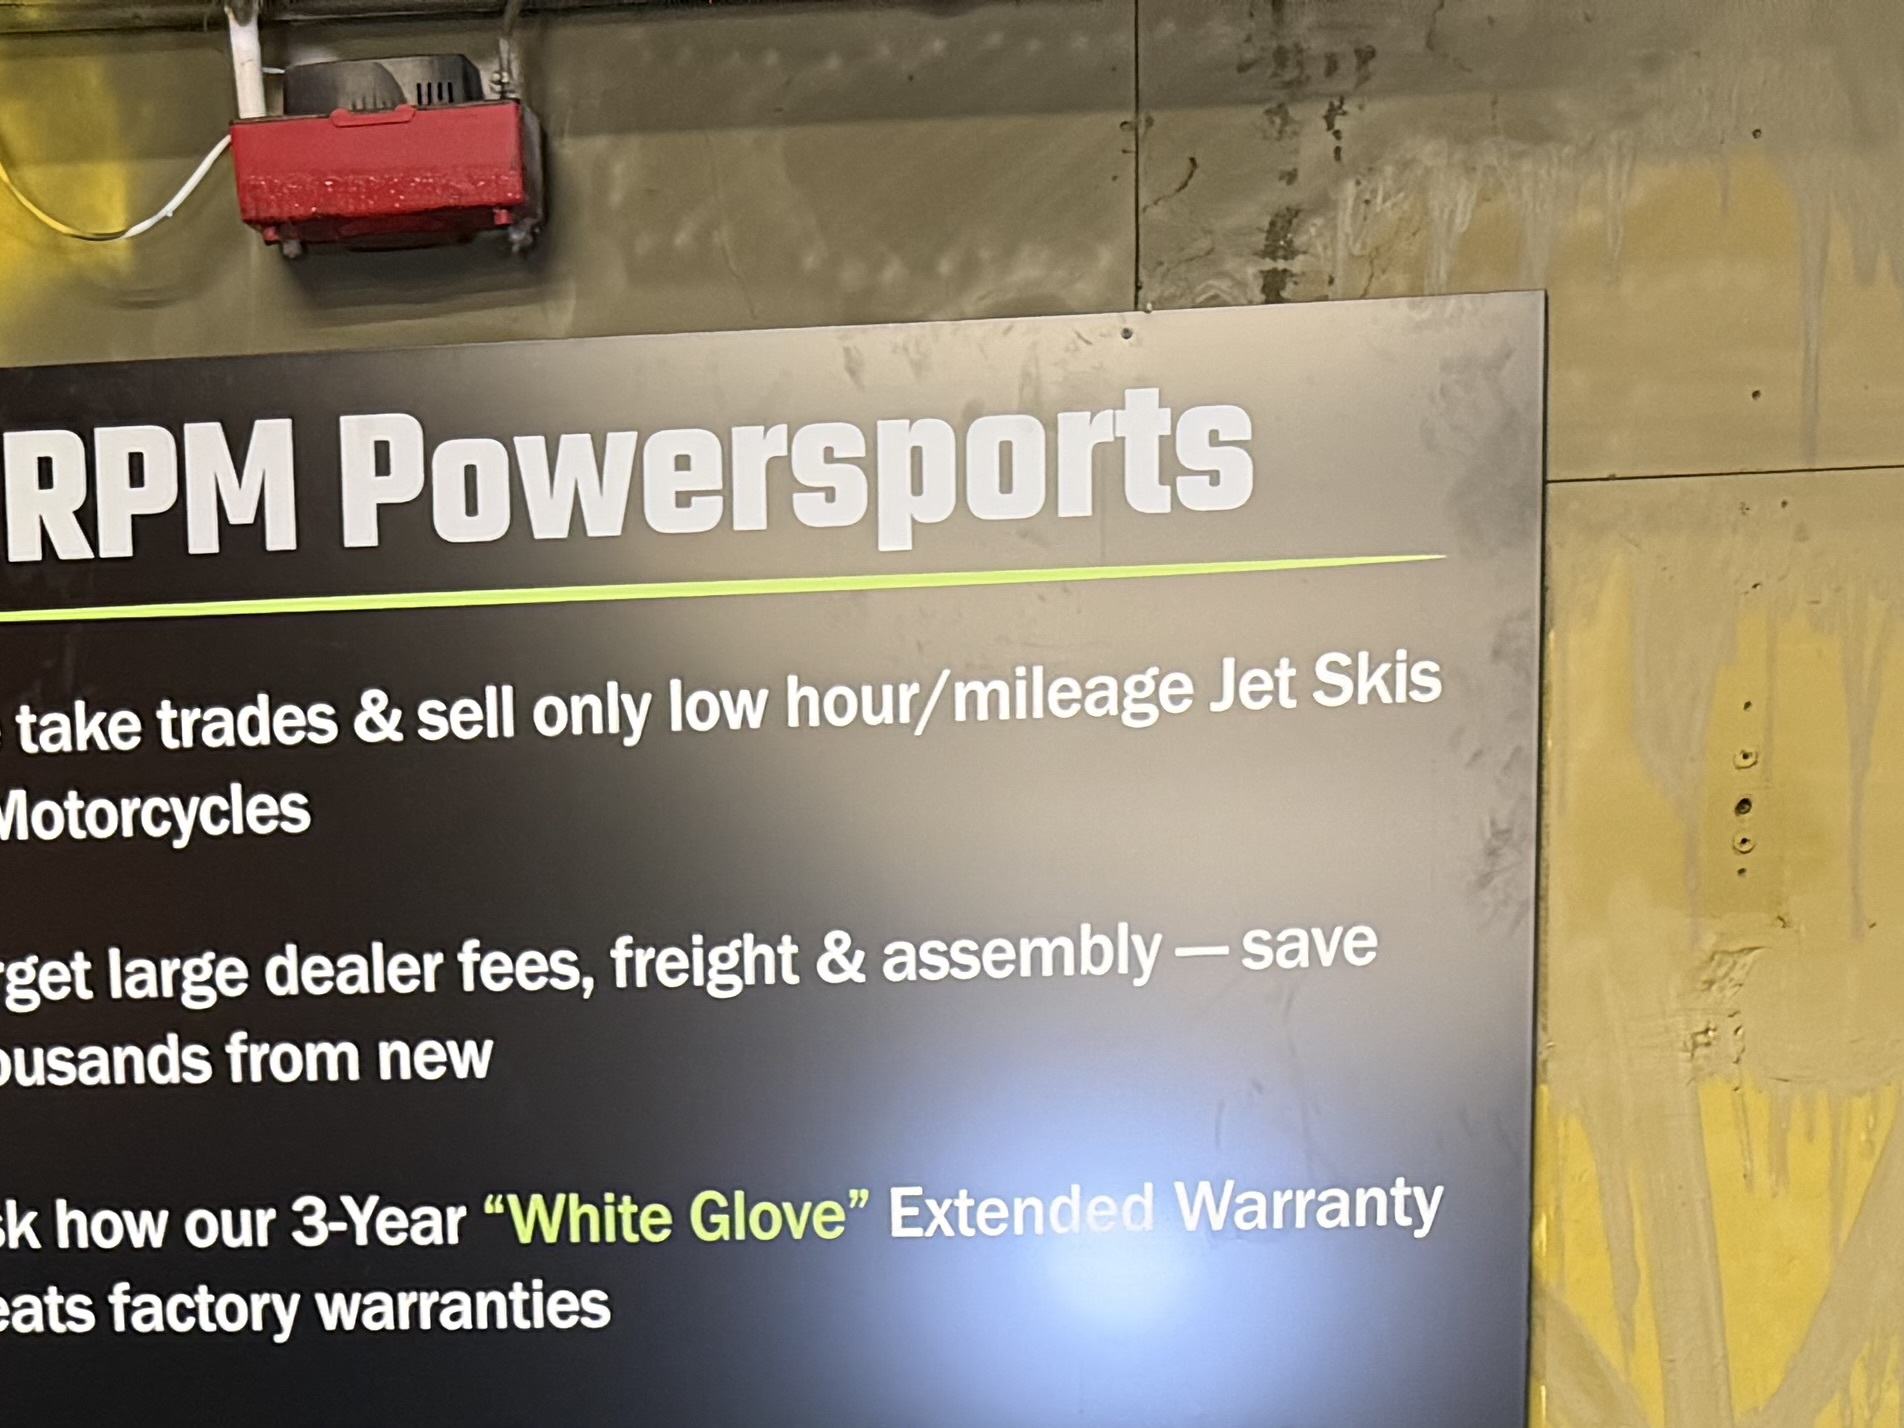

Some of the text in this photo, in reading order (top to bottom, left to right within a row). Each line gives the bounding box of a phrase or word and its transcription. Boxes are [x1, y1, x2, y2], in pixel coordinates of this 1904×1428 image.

[3, 388, 1253, 562] RPM Powersports
[15, 700, 141, 753] take
[156, 694, 338, 749] trades
[354, 689, 403, 742] &
[418, 685, 514, 740] sell
[534, 681, 651, 746] only
[670, 679, 768, 731] low
[788, 666, 1193, 735] hour/mileage
[1210, 657, 1297, 711] Jet
[1313, 649, 1441, 706] Skis
[109, 947, 248, 1009] large
[265, 942, 443, 996] dealer
[457, 939, 593, 999] fees,
[610, 933, 799, 998] freight
[817, 930, 865, 983] &
[883, 922, 1162, 986] assembly
[1242, 926, 1377, 970] save
[225, 1031, 359, 1082] from
[379, 1040, 493, 1080] new
[56, 1199, 169, 1248] how
[185, 1208, 276, 1248] our
[292, 1195, 466, 1246] 3-Year
[891, 1183, 1153, 1239] Extended
[1175, 1177, 1444, 1239] Warranty
[108, 1282, 300, 1343] factory
[315, 1279, 610, 1330] warranties
